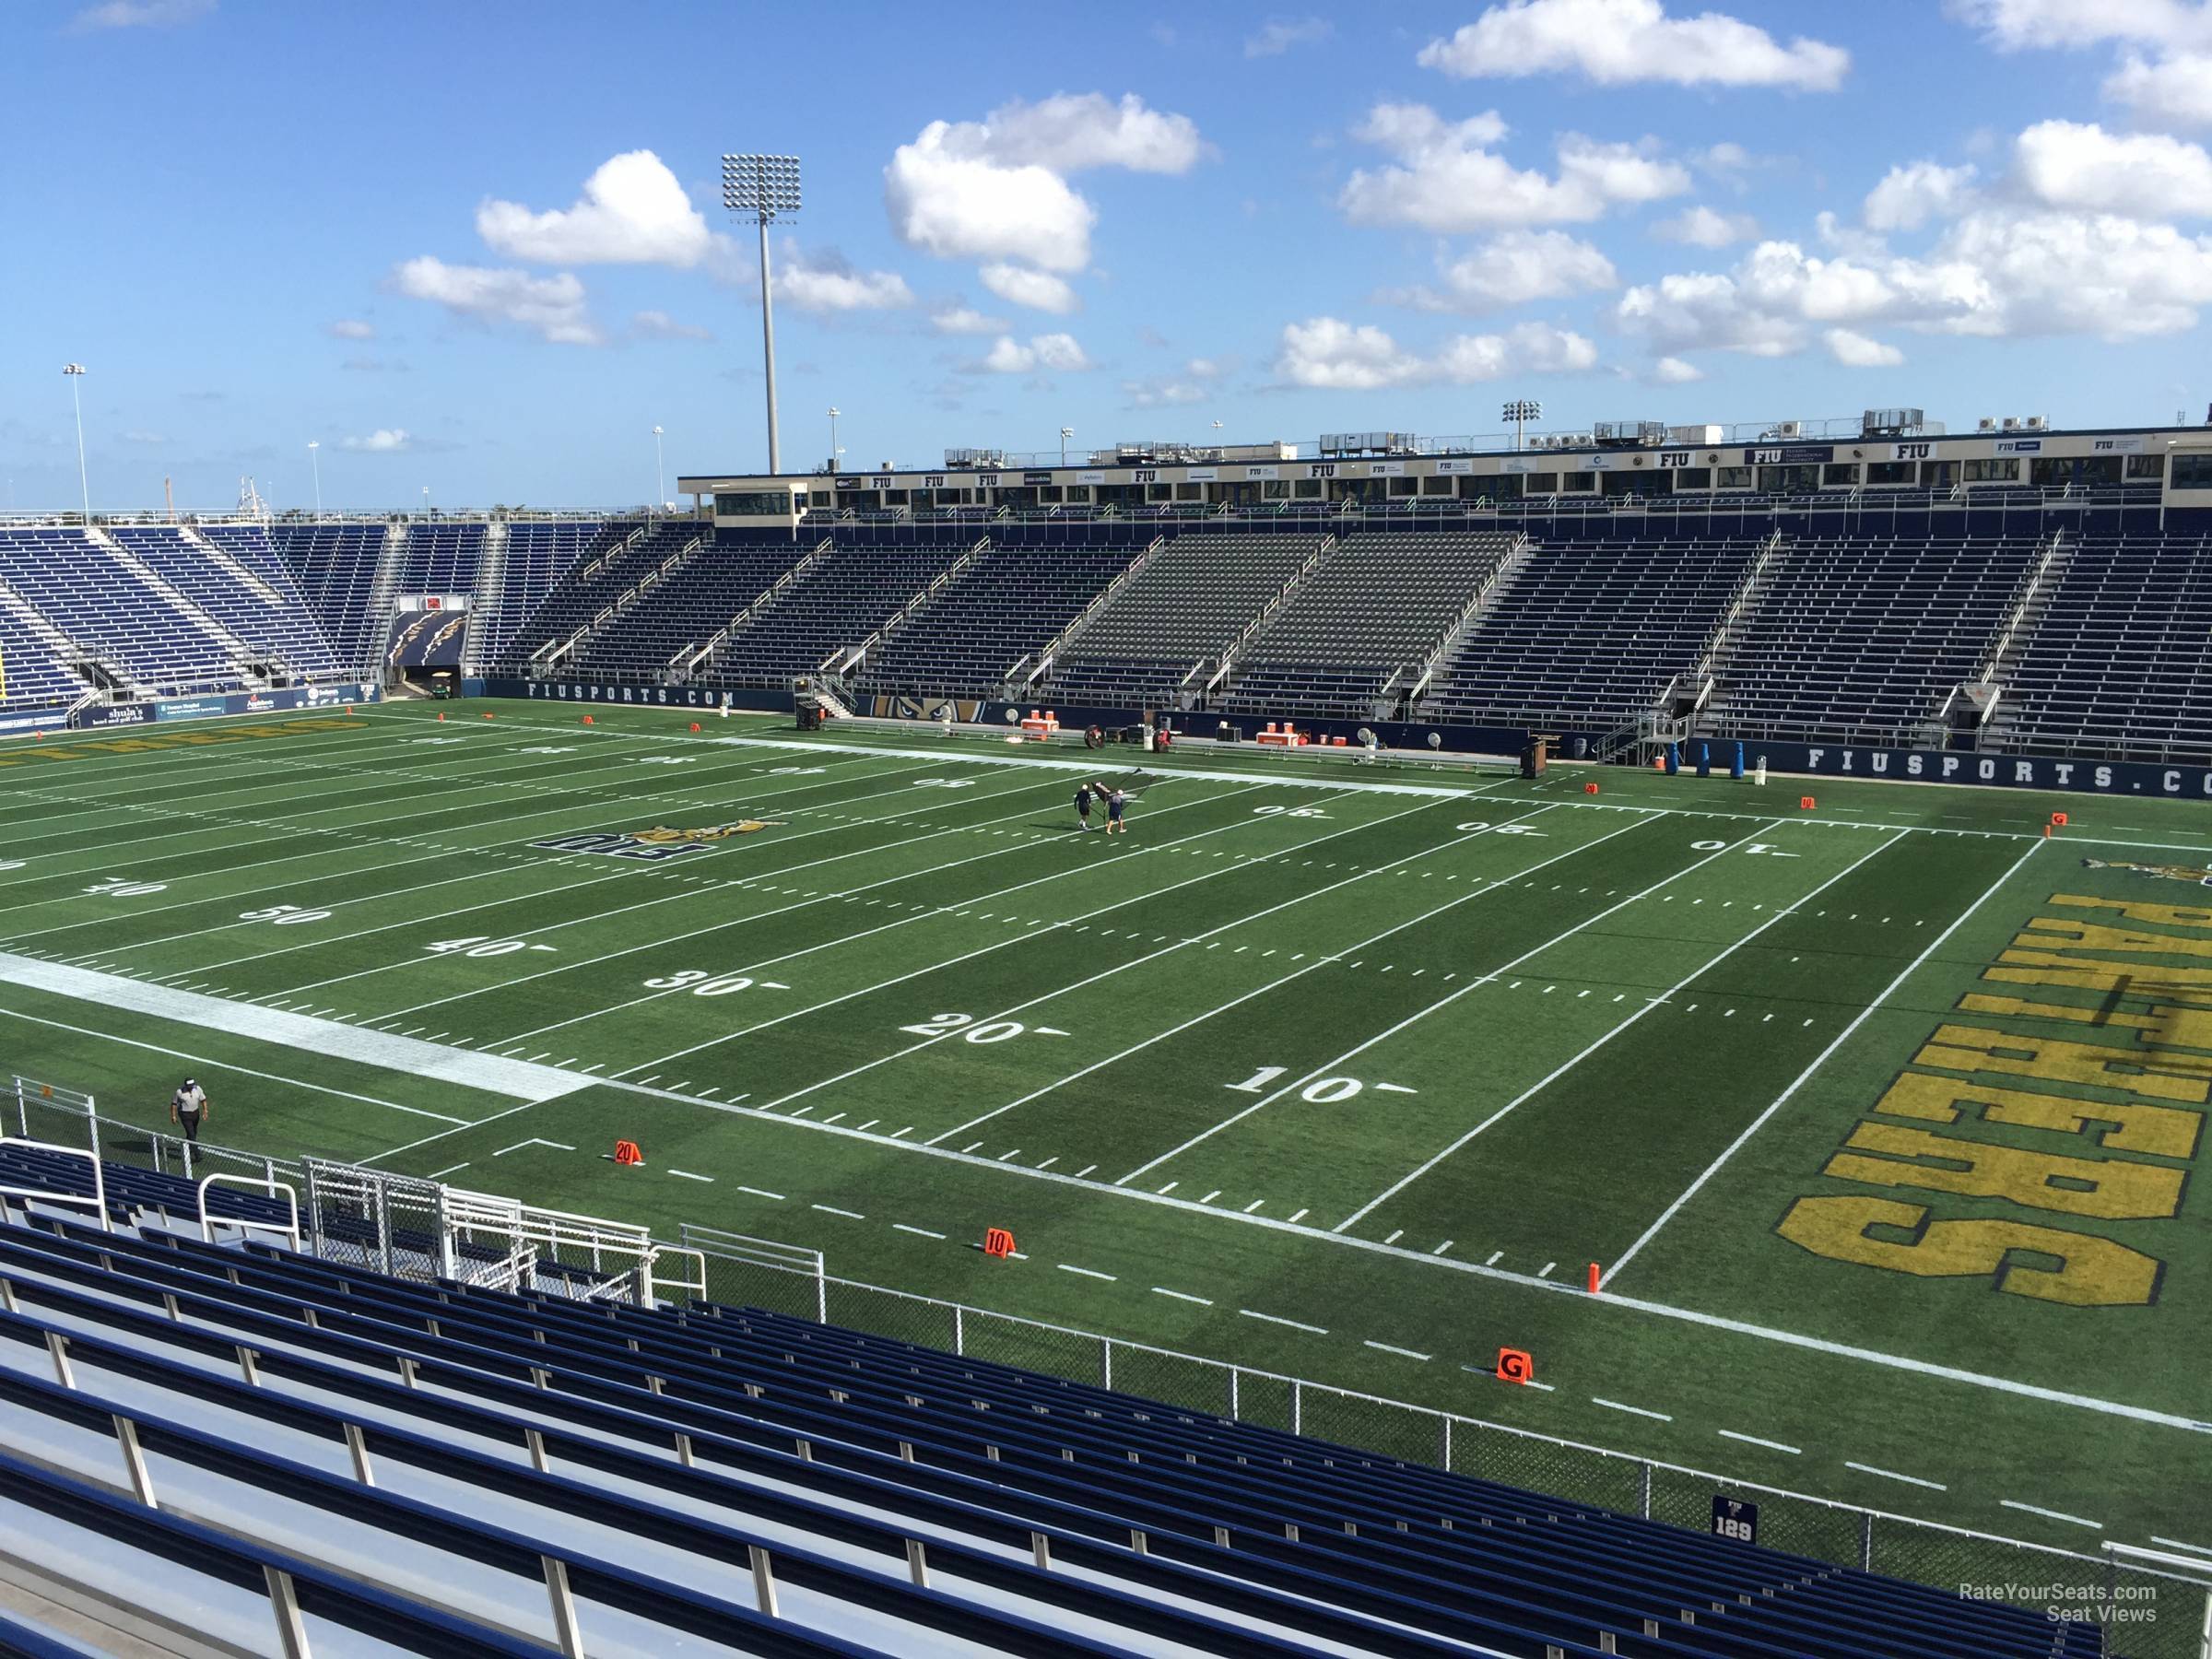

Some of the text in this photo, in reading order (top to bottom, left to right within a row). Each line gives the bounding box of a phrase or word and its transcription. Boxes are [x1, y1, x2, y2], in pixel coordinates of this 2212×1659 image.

[1660, 453, 1689, 467] FIU
[1754, 449, 1783, 463] FIU
[1897, 444, 1930, 459] FIU
[1135, 470, 1156, 482] FIU
[1312, 465, 1335, 477] FIU
[873, 477, 891, 488] FIU
[924, 476, 944, 487] FIU
[979, 475, 997, 487] FIU
[528, 683, 734, 706] FIUSPORTS.COM
[2053, 815, 2065, 824] G
[239, 906, 333, 925] 50
[422, 935, 526, 958] 40
[643, 971, 754, 996] 30
[899, 1012, 1026, 1044] 20
[1225, 1065, 1365, 1104] 10
[617, 1142, 631, 1161] 20
[989, 1230, 1006, 1253] 10
[1501, 1354, 1523, 1377] G
[1715, 1515, 1752, 1542] 129
